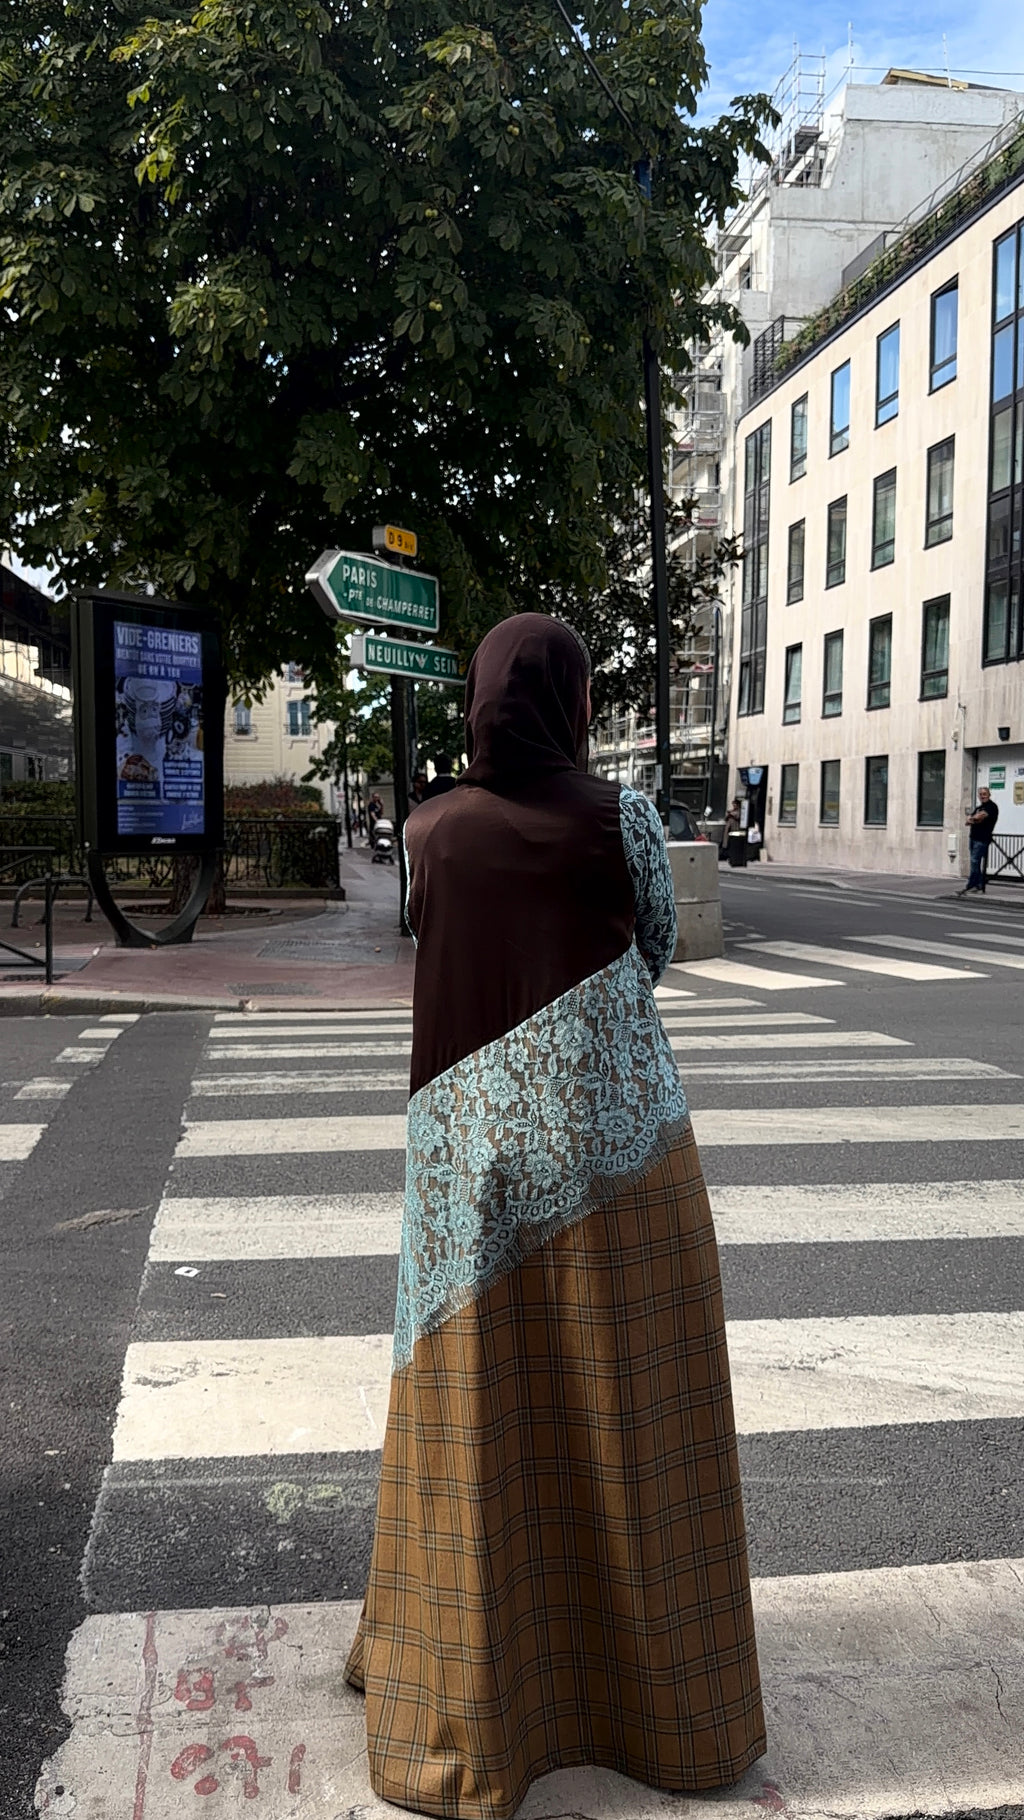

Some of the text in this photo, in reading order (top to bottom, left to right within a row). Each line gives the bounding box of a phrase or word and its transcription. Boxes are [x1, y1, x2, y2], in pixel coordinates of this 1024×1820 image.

[388, 531, 395, 545] D
[396, 534, 403, 547] 9
[342, 564, 378, 588] PARIS
[376, 596, 435, 620] CHAMPERRET
[116, 626, 199, 654] VIDE-GRENIERS
[367, 644, 415, 667] NEUILLY
